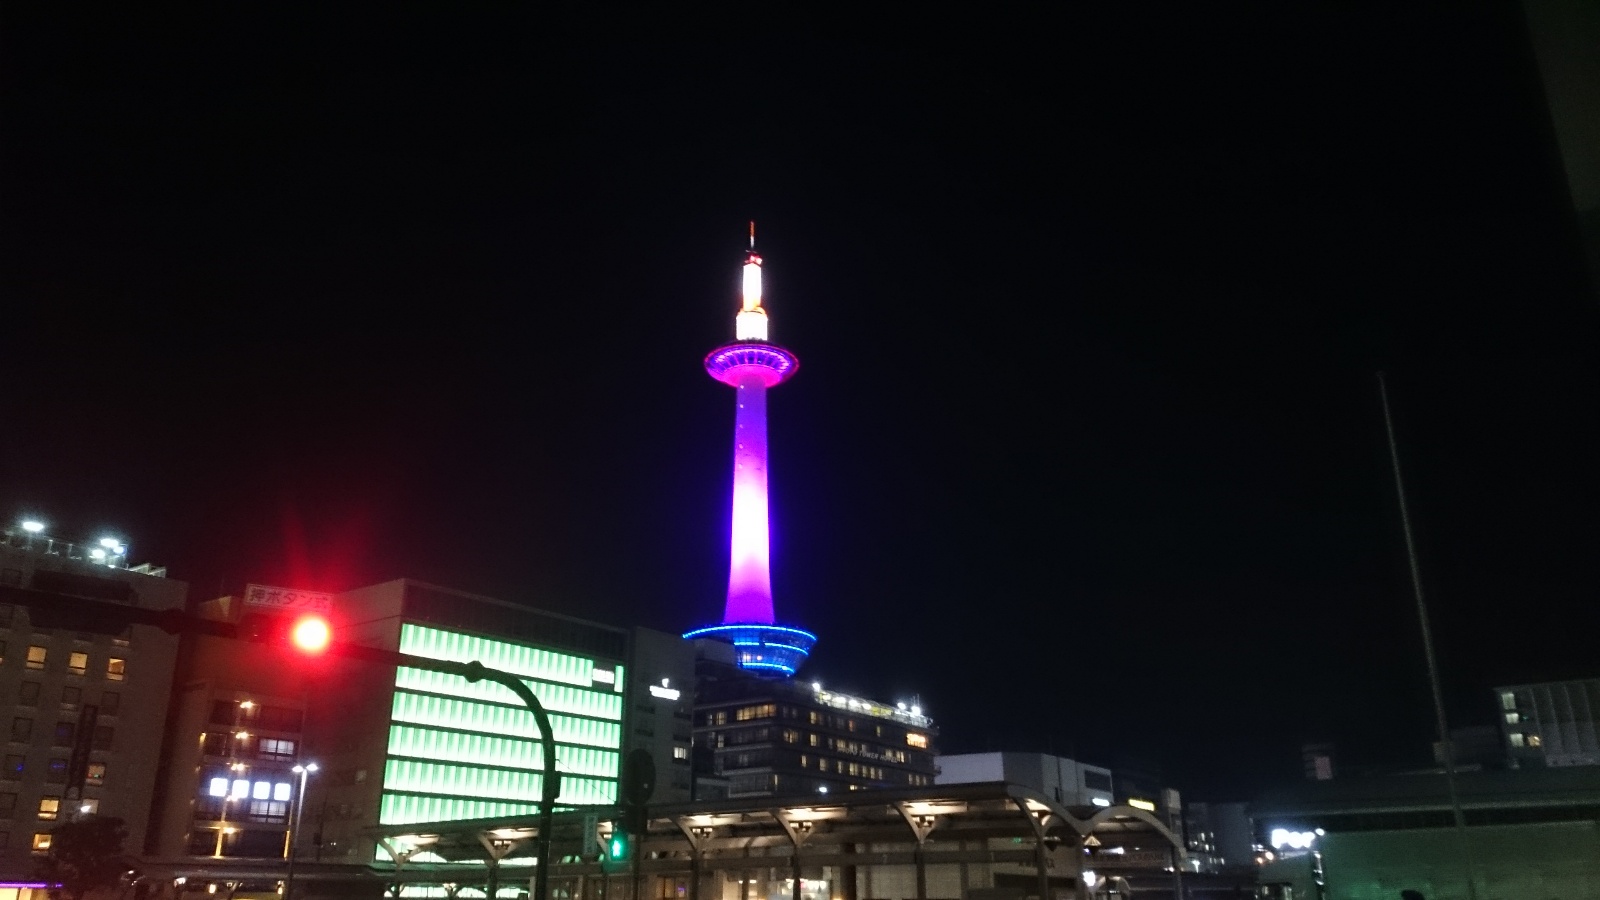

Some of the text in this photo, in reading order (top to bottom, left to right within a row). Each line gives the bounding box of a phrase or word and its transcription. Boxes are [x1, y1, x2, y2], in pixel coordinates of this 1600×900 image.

[249, 587, 329, 610] 押ボタン式
[859, 750, 879, 760] TOWER
